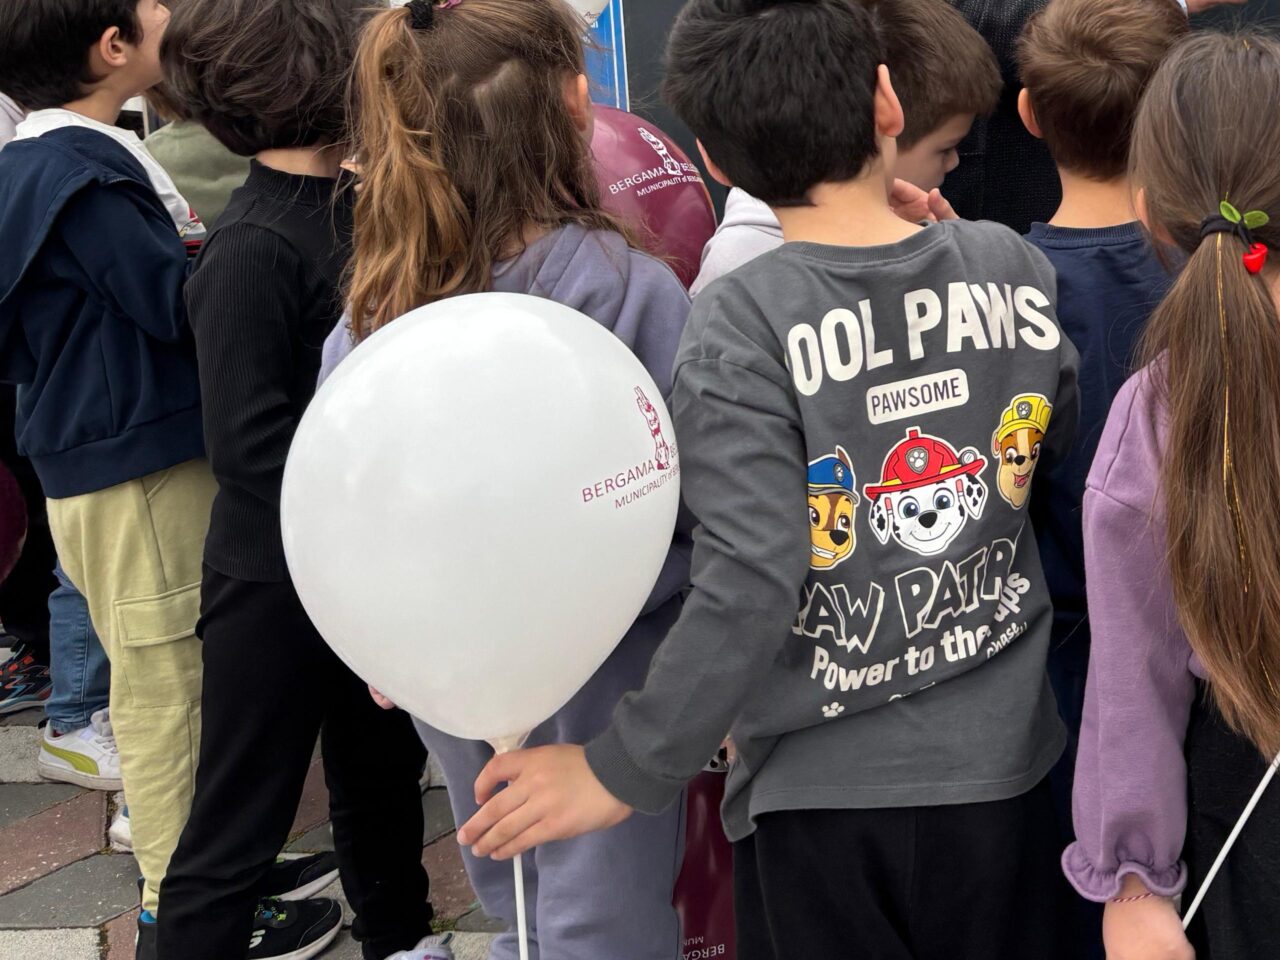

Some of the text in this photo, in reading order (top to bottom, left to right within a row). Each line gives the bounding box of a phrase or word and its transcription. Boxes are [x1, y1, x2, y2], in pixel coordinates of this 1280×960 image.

[608, 166, 666, 195] BERGAMA
[636, 178, 682, 196] MUNICIPALITY
[786, 282, 1060, 396] OOL PAWS
[871, 377, 962, 417] PAWSOME
[582, 459, 655, 502] BERGAMA
[615, 473, 669, 509] MUNICIPALITY
[895, 538, 1016, 639] PATR
[810, 645, 900, 692] Power
[904, 646, 934, 676] to
